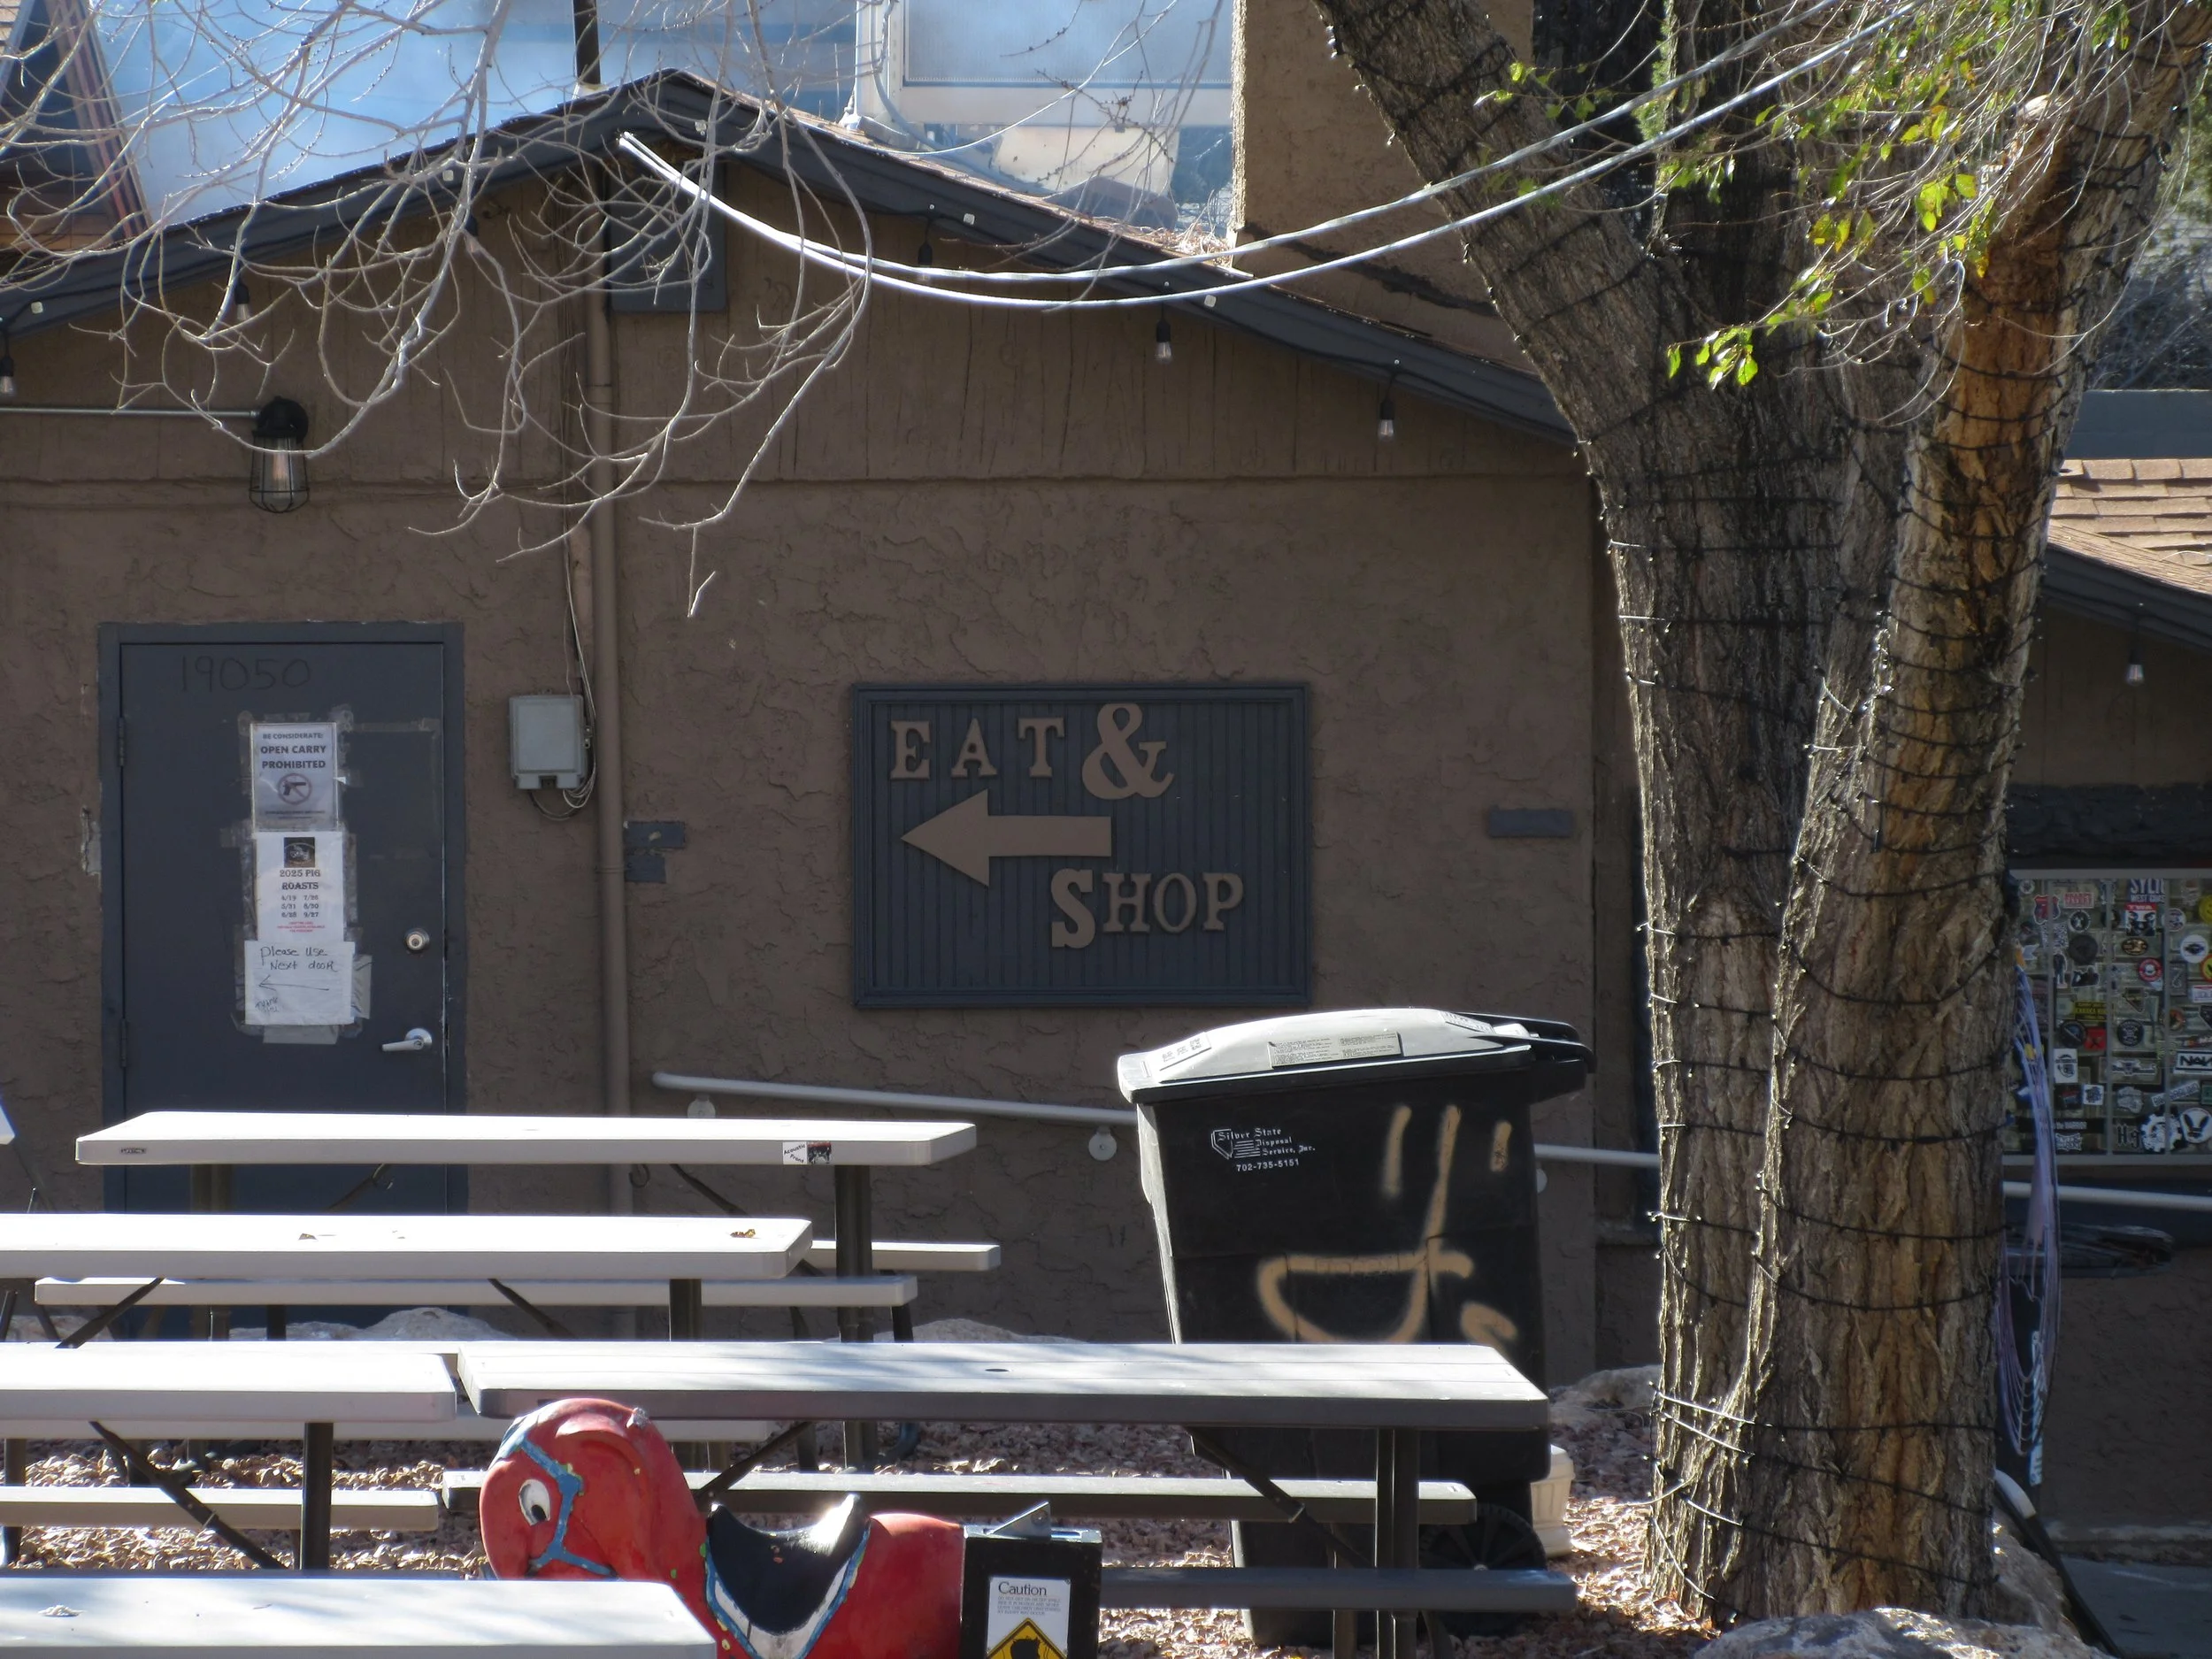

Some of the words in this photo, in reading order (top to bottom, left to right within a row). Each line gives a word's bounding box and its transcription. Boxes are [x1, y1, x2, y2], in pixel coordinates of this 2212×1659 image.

[182, 655, 311, 692] 19050
[260, 745, 289, 754] OPEN
[292, 745, 326, 754] CARRY
[889, 718, 1064, 780] EAT
[1081, 703, 1175, 800] &
[262, 760, 326, 769] PROHIBITED
[280, 869, 303, 878] 2025
[305, 869, 321, 878] PIG
[281, 881, 319, 890] ROASTS
[1050, 868, 1243, 949] SHOP
[1217, 1132, 1250, 1141] Silver
[1254, 1127, 1281, 1138] State
[1255, 1136, 1293, 1147] Disposal
[1236, 1158, 1300, 1172] 702-735-5151
[998, 1581, 1047, 1596] Caution
